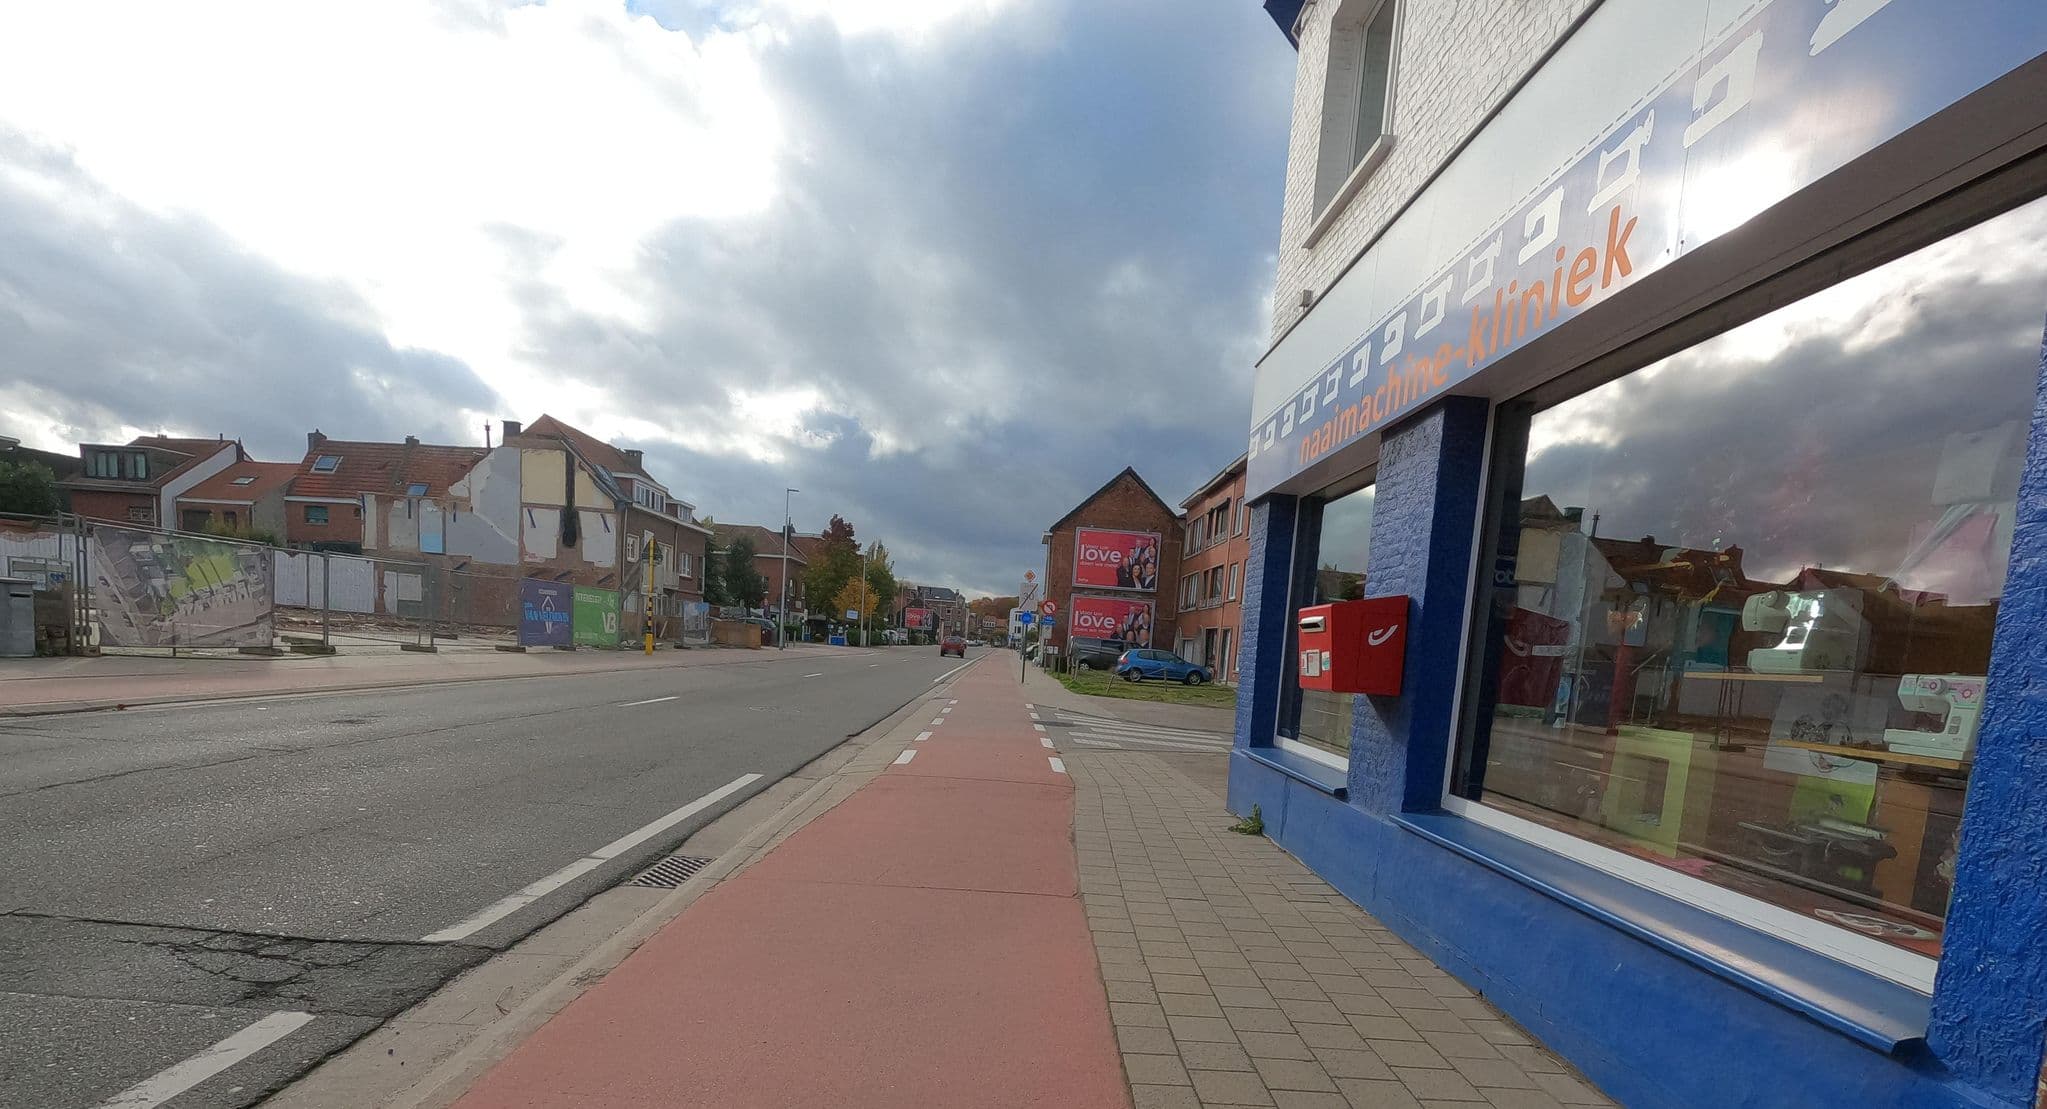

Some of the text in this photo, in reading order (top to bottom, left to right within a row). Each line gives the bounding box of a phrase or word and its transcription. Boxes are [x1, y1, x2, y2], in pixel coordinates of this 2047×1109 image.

[1299, 204, 1639, 466] naaimachine-kliniek
[1080, 544, 1122, 563] love
[1023, 591, 1035, 601] 30
[1074, 610, 1116, 629] love
